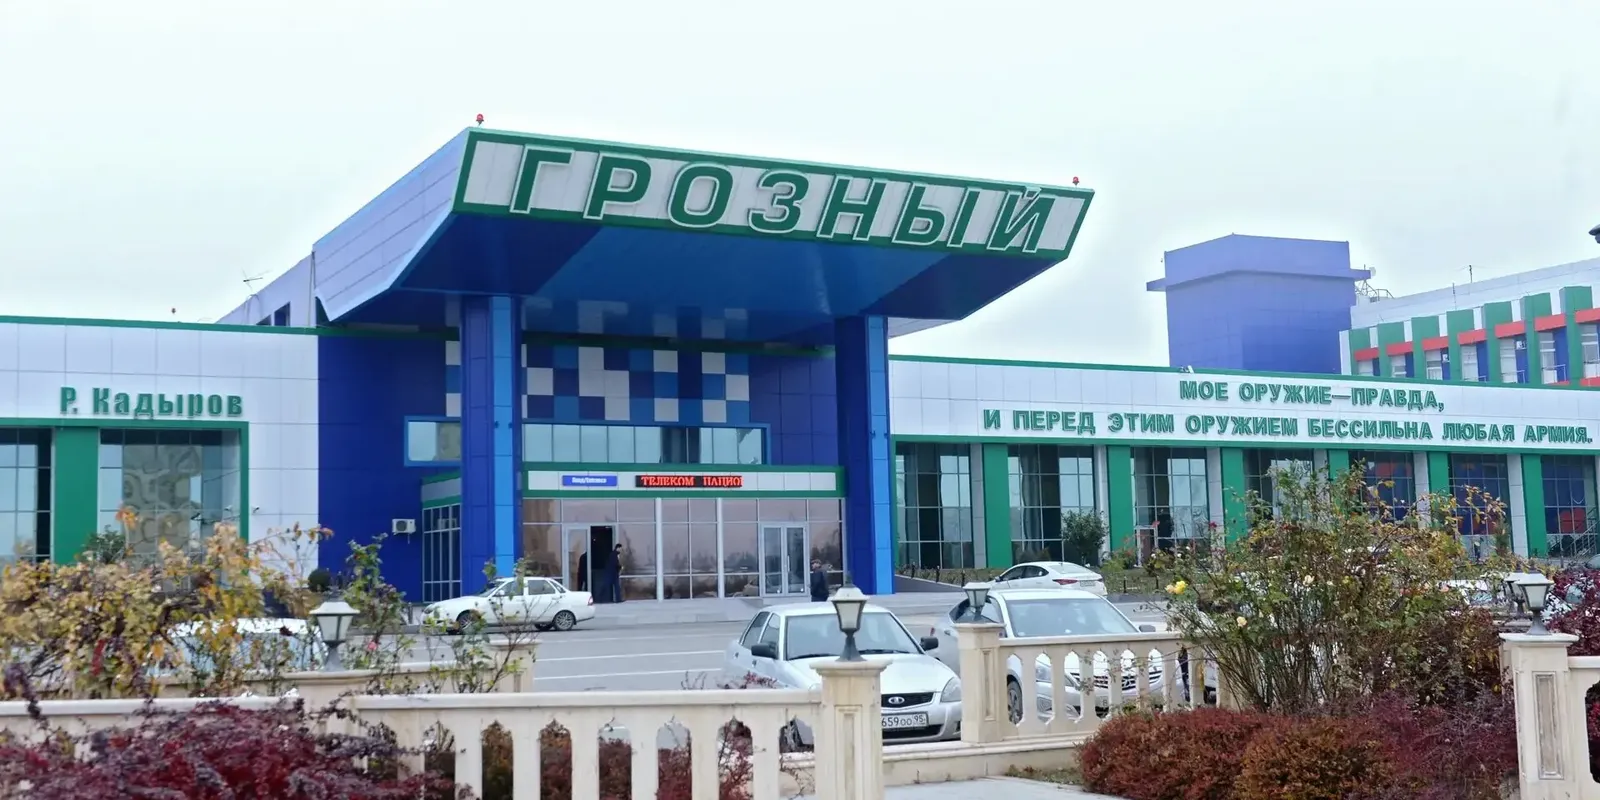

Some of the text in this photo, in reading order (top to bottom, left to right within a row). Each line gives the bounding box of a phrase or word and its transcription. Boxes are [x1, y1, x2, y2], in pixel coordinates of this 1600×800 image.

[510, 142, 1057, 253] ГРОЗНЫЙ
[60, 386, 244, 419] Р. Кадыров
[1179, 380, 1229, 401] МОЕ
[983, 409, 1594, 444] И ПЕРЕД ЭТИМ ОРУЖИЕМ БЕССИЛЬНА ЛЮБАЯ АРМИЯ.
[641, 475, 695, 487] ТЕЛЕКОМ
